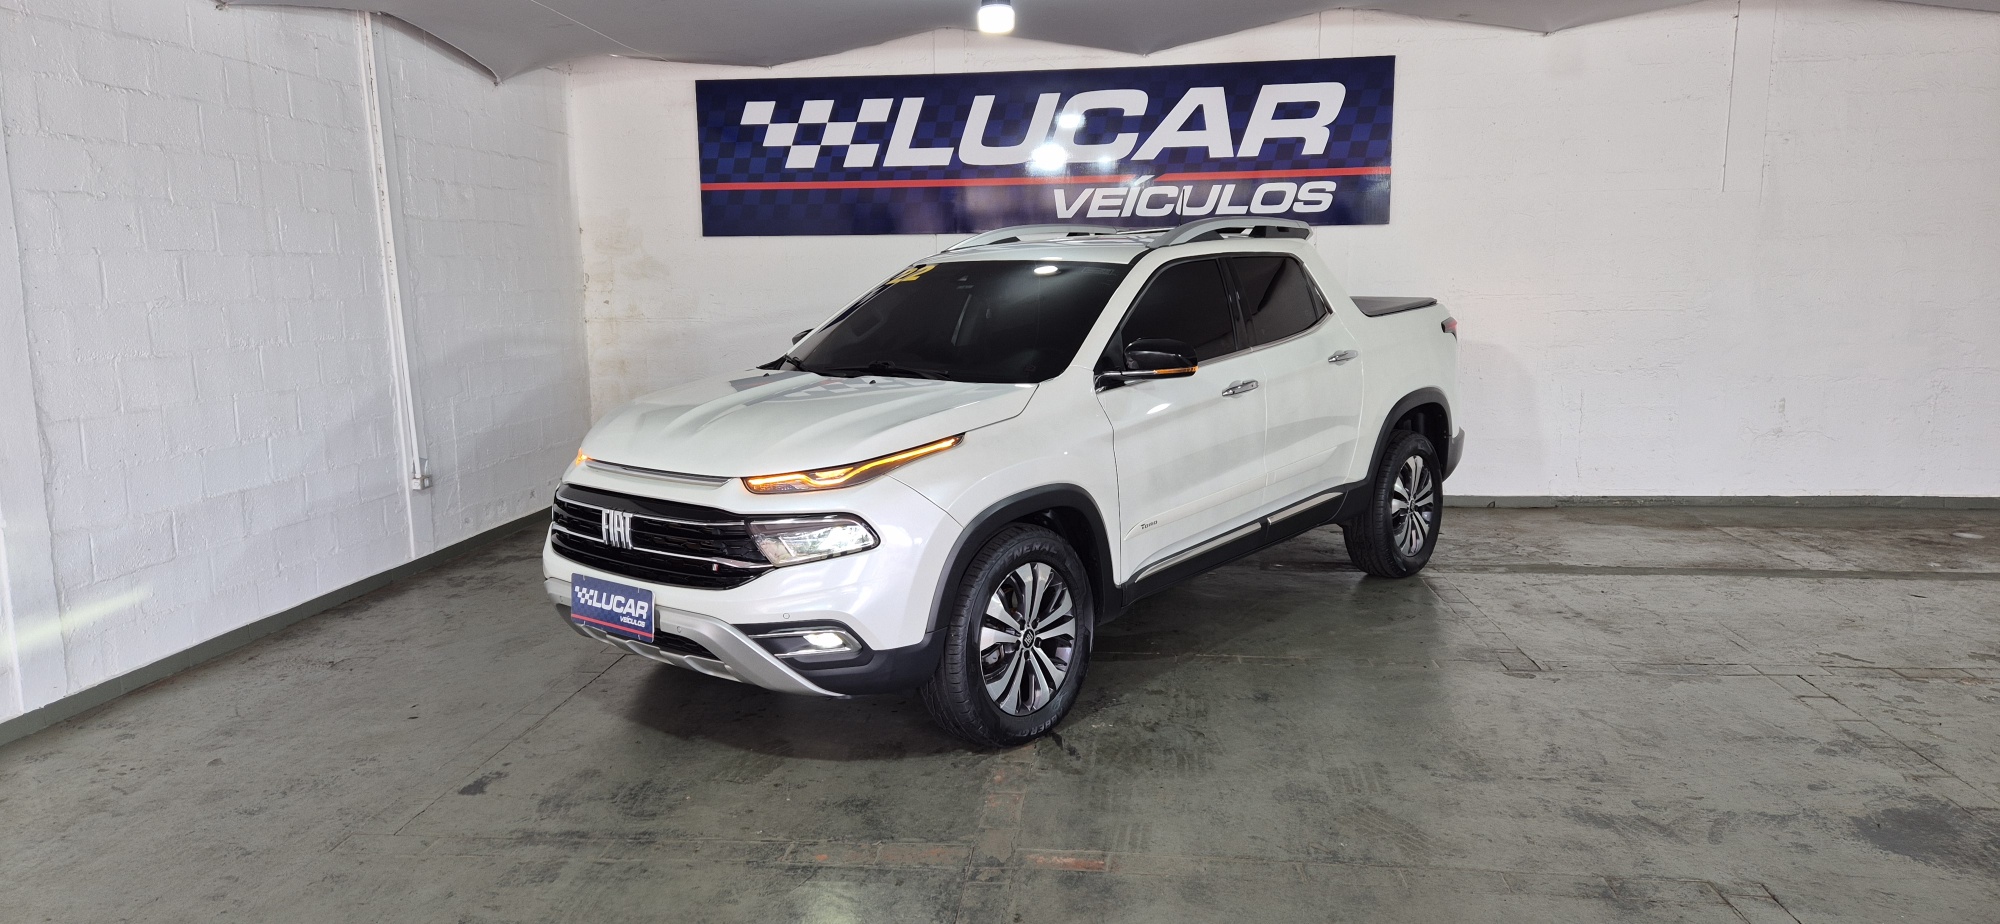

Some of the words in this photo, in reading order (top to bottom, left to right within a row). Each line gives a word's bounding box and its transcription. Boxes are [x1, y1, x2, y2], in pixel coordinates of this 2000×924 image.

[883, 81, 1347, 167] LUCAR
[1053, 175, 1337, 219] VEÍCULOS
[601, 508, 634, 550] FIAT
[592, 590, 649, 619] LUCAR
